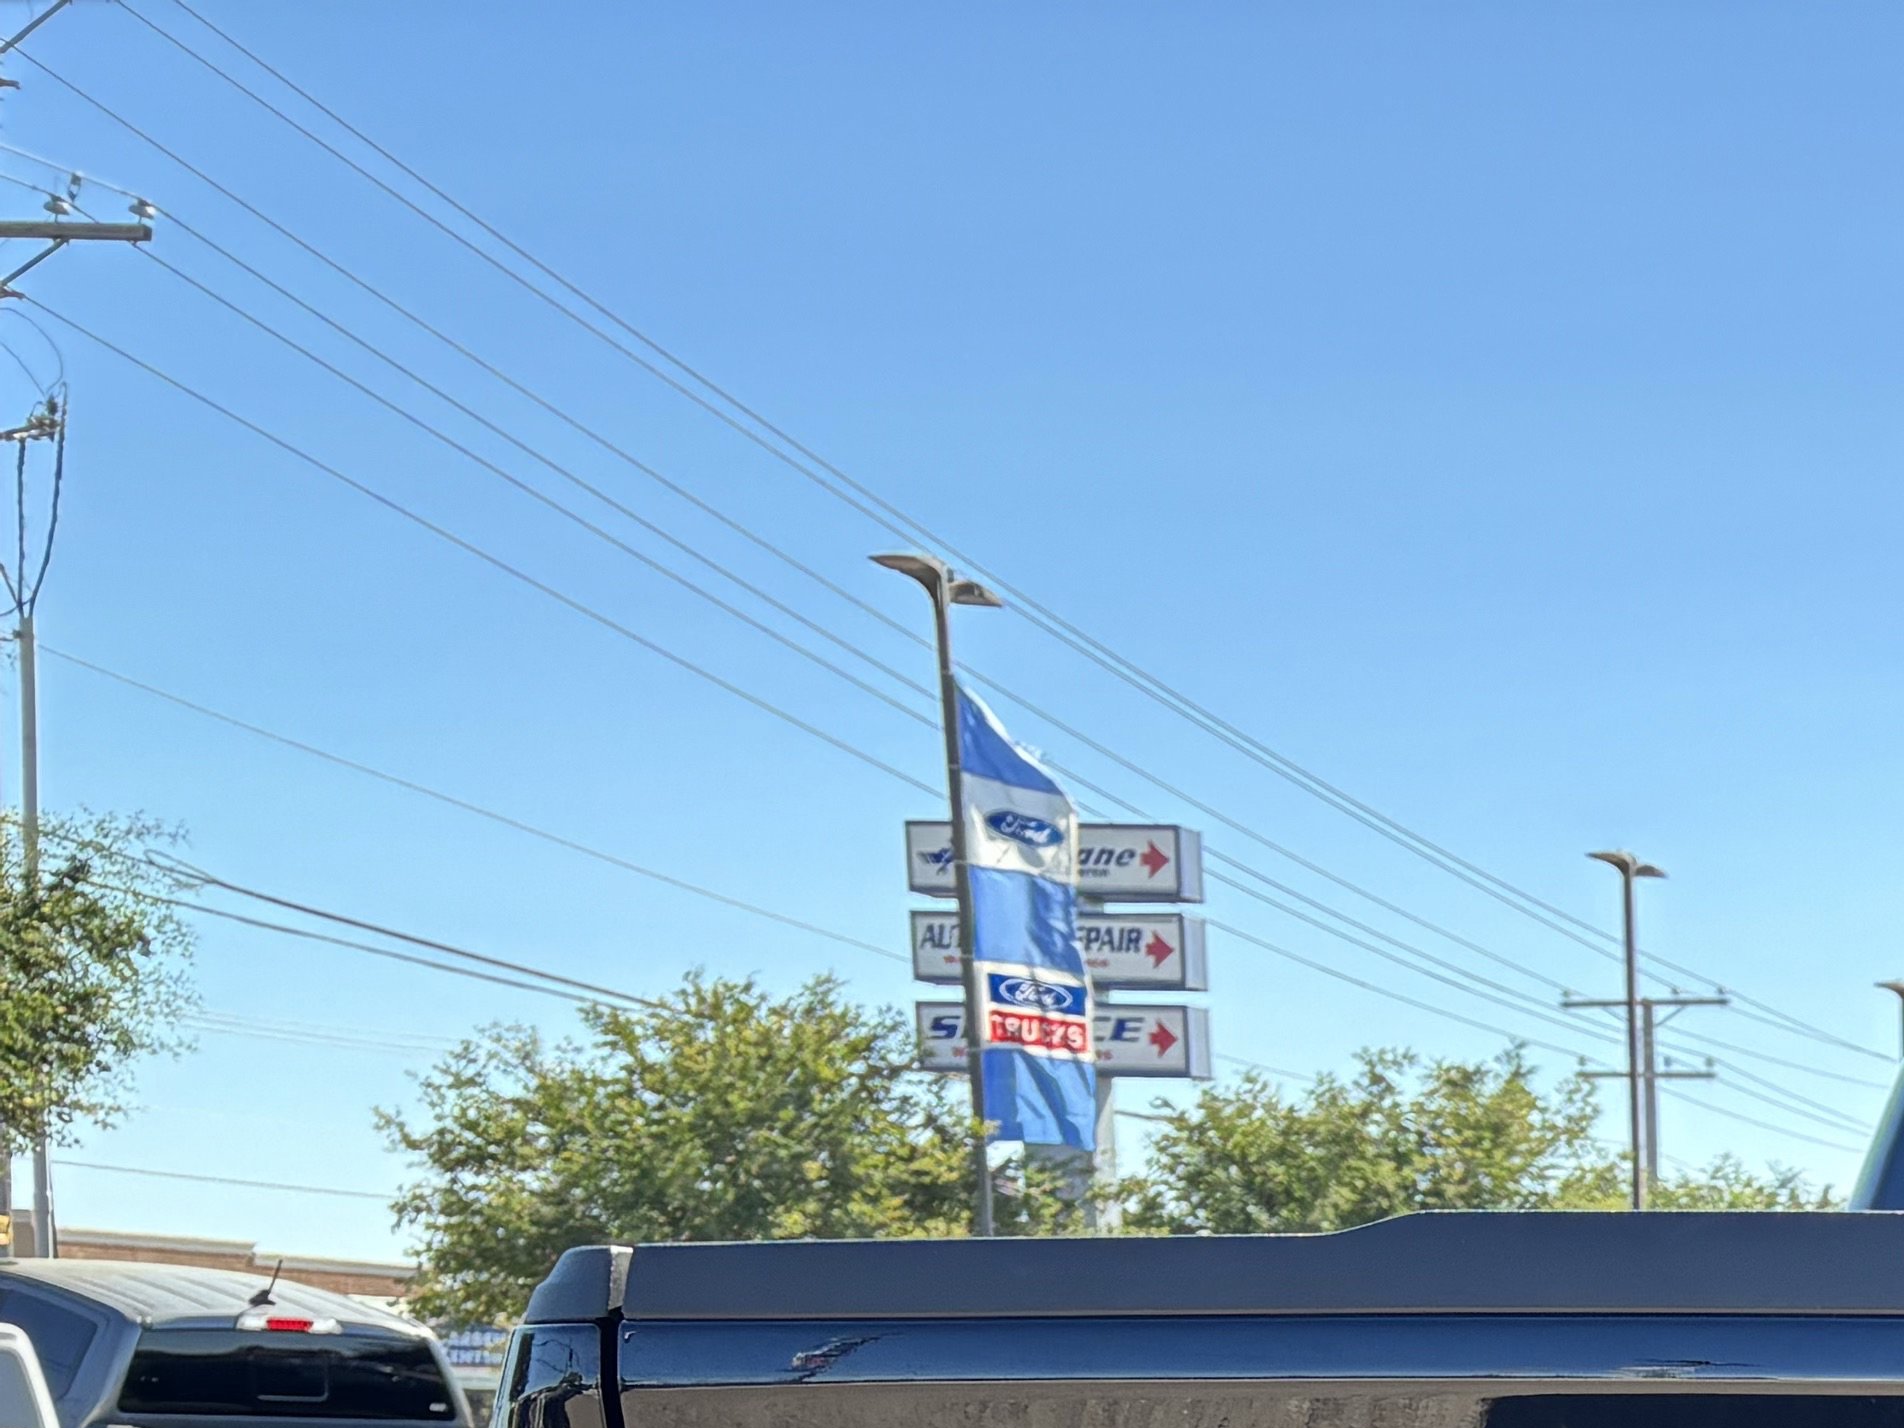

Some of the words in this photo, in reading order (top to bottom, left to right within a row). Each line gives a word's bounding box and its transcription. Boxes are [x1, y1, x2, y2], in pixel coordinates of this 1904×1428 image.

[1078, 847, 1136, 867] ane
[919, 922, 961, 949] AUT
[1077, 925, 1143, 953] PAIR
